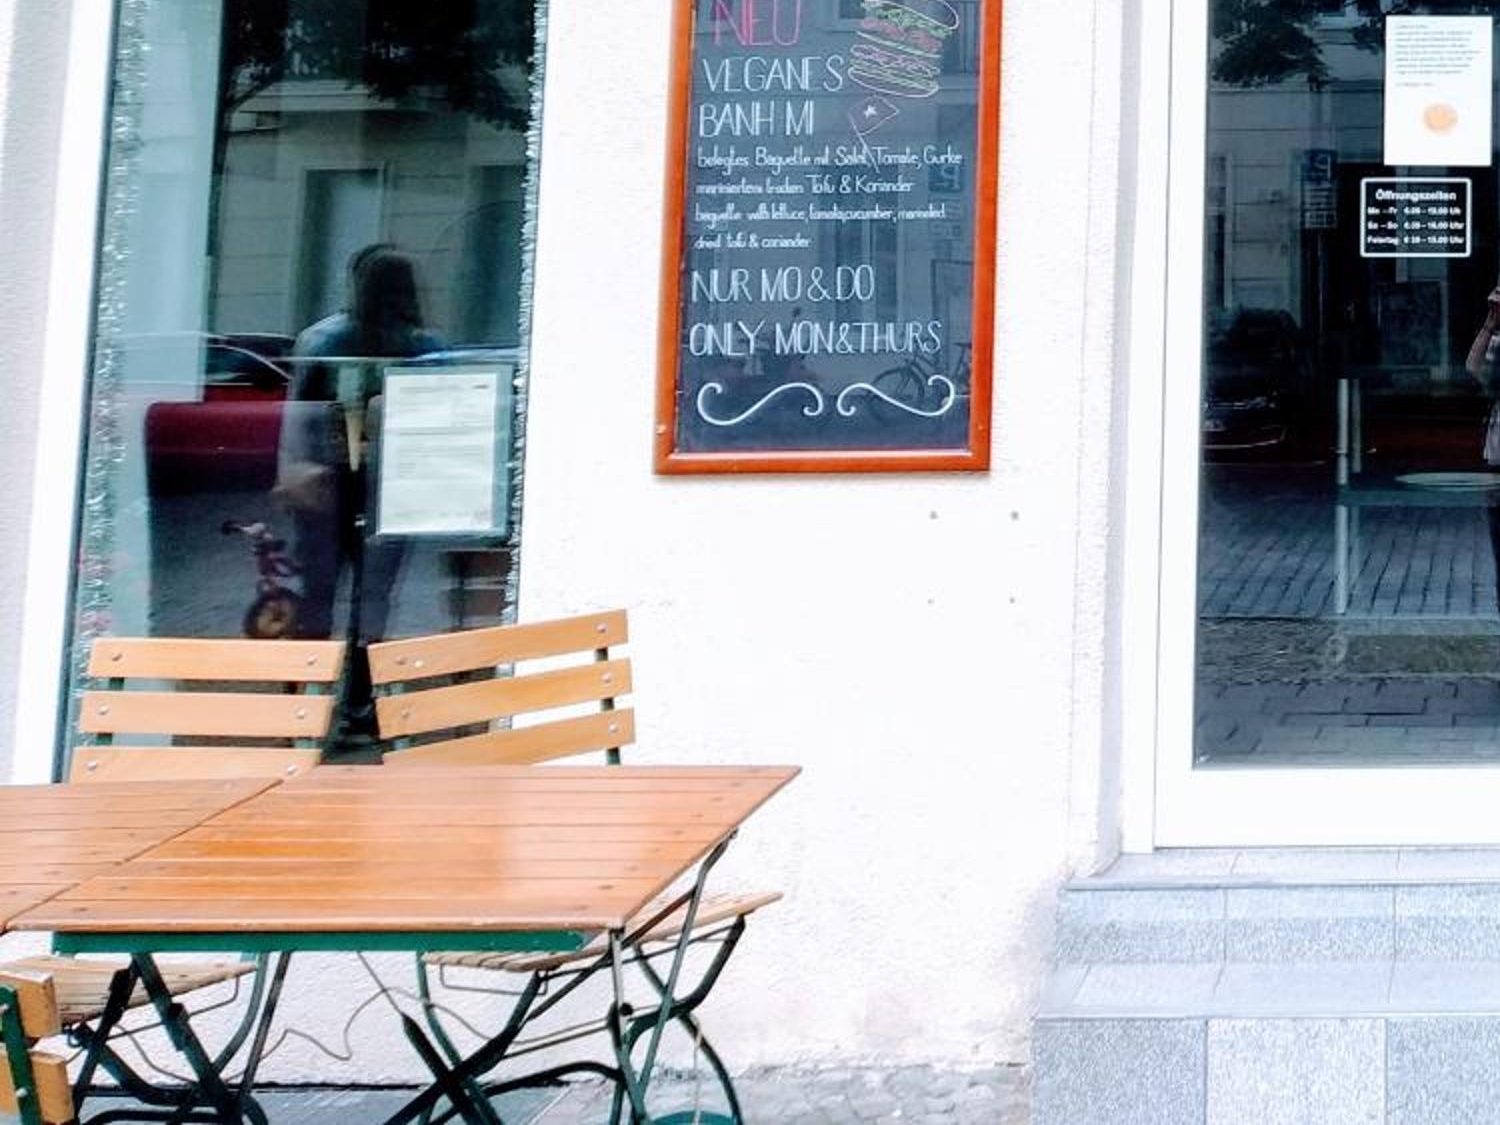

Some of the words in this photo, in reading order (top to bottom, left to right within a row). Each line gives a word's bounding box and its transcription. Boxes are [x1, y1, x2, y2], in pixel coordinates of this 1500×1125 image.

[702, 55, 845, 93] VEGANES
[699, 101, 775, 137] BANH
[785, 100, 815, 136] MI
[697, 144, 750, 175] belegtes
[923, 144, 963, 165] Gurke
[805, 174, 836, 194] Tofu
[839, 175, 852, 194] &
[855, 174, 915, 194] Koriander
[1375, 188, 1457, 203] Öffnungszeiten
[748, 232, 759, 248] &
[691, 268, 752, 302] NUR
[761, 266, 801, 302] MO
[806, 266, 832, 302] &
[836, 265, 876, 302] DO
[689, 321, 765, 357] ONLY
